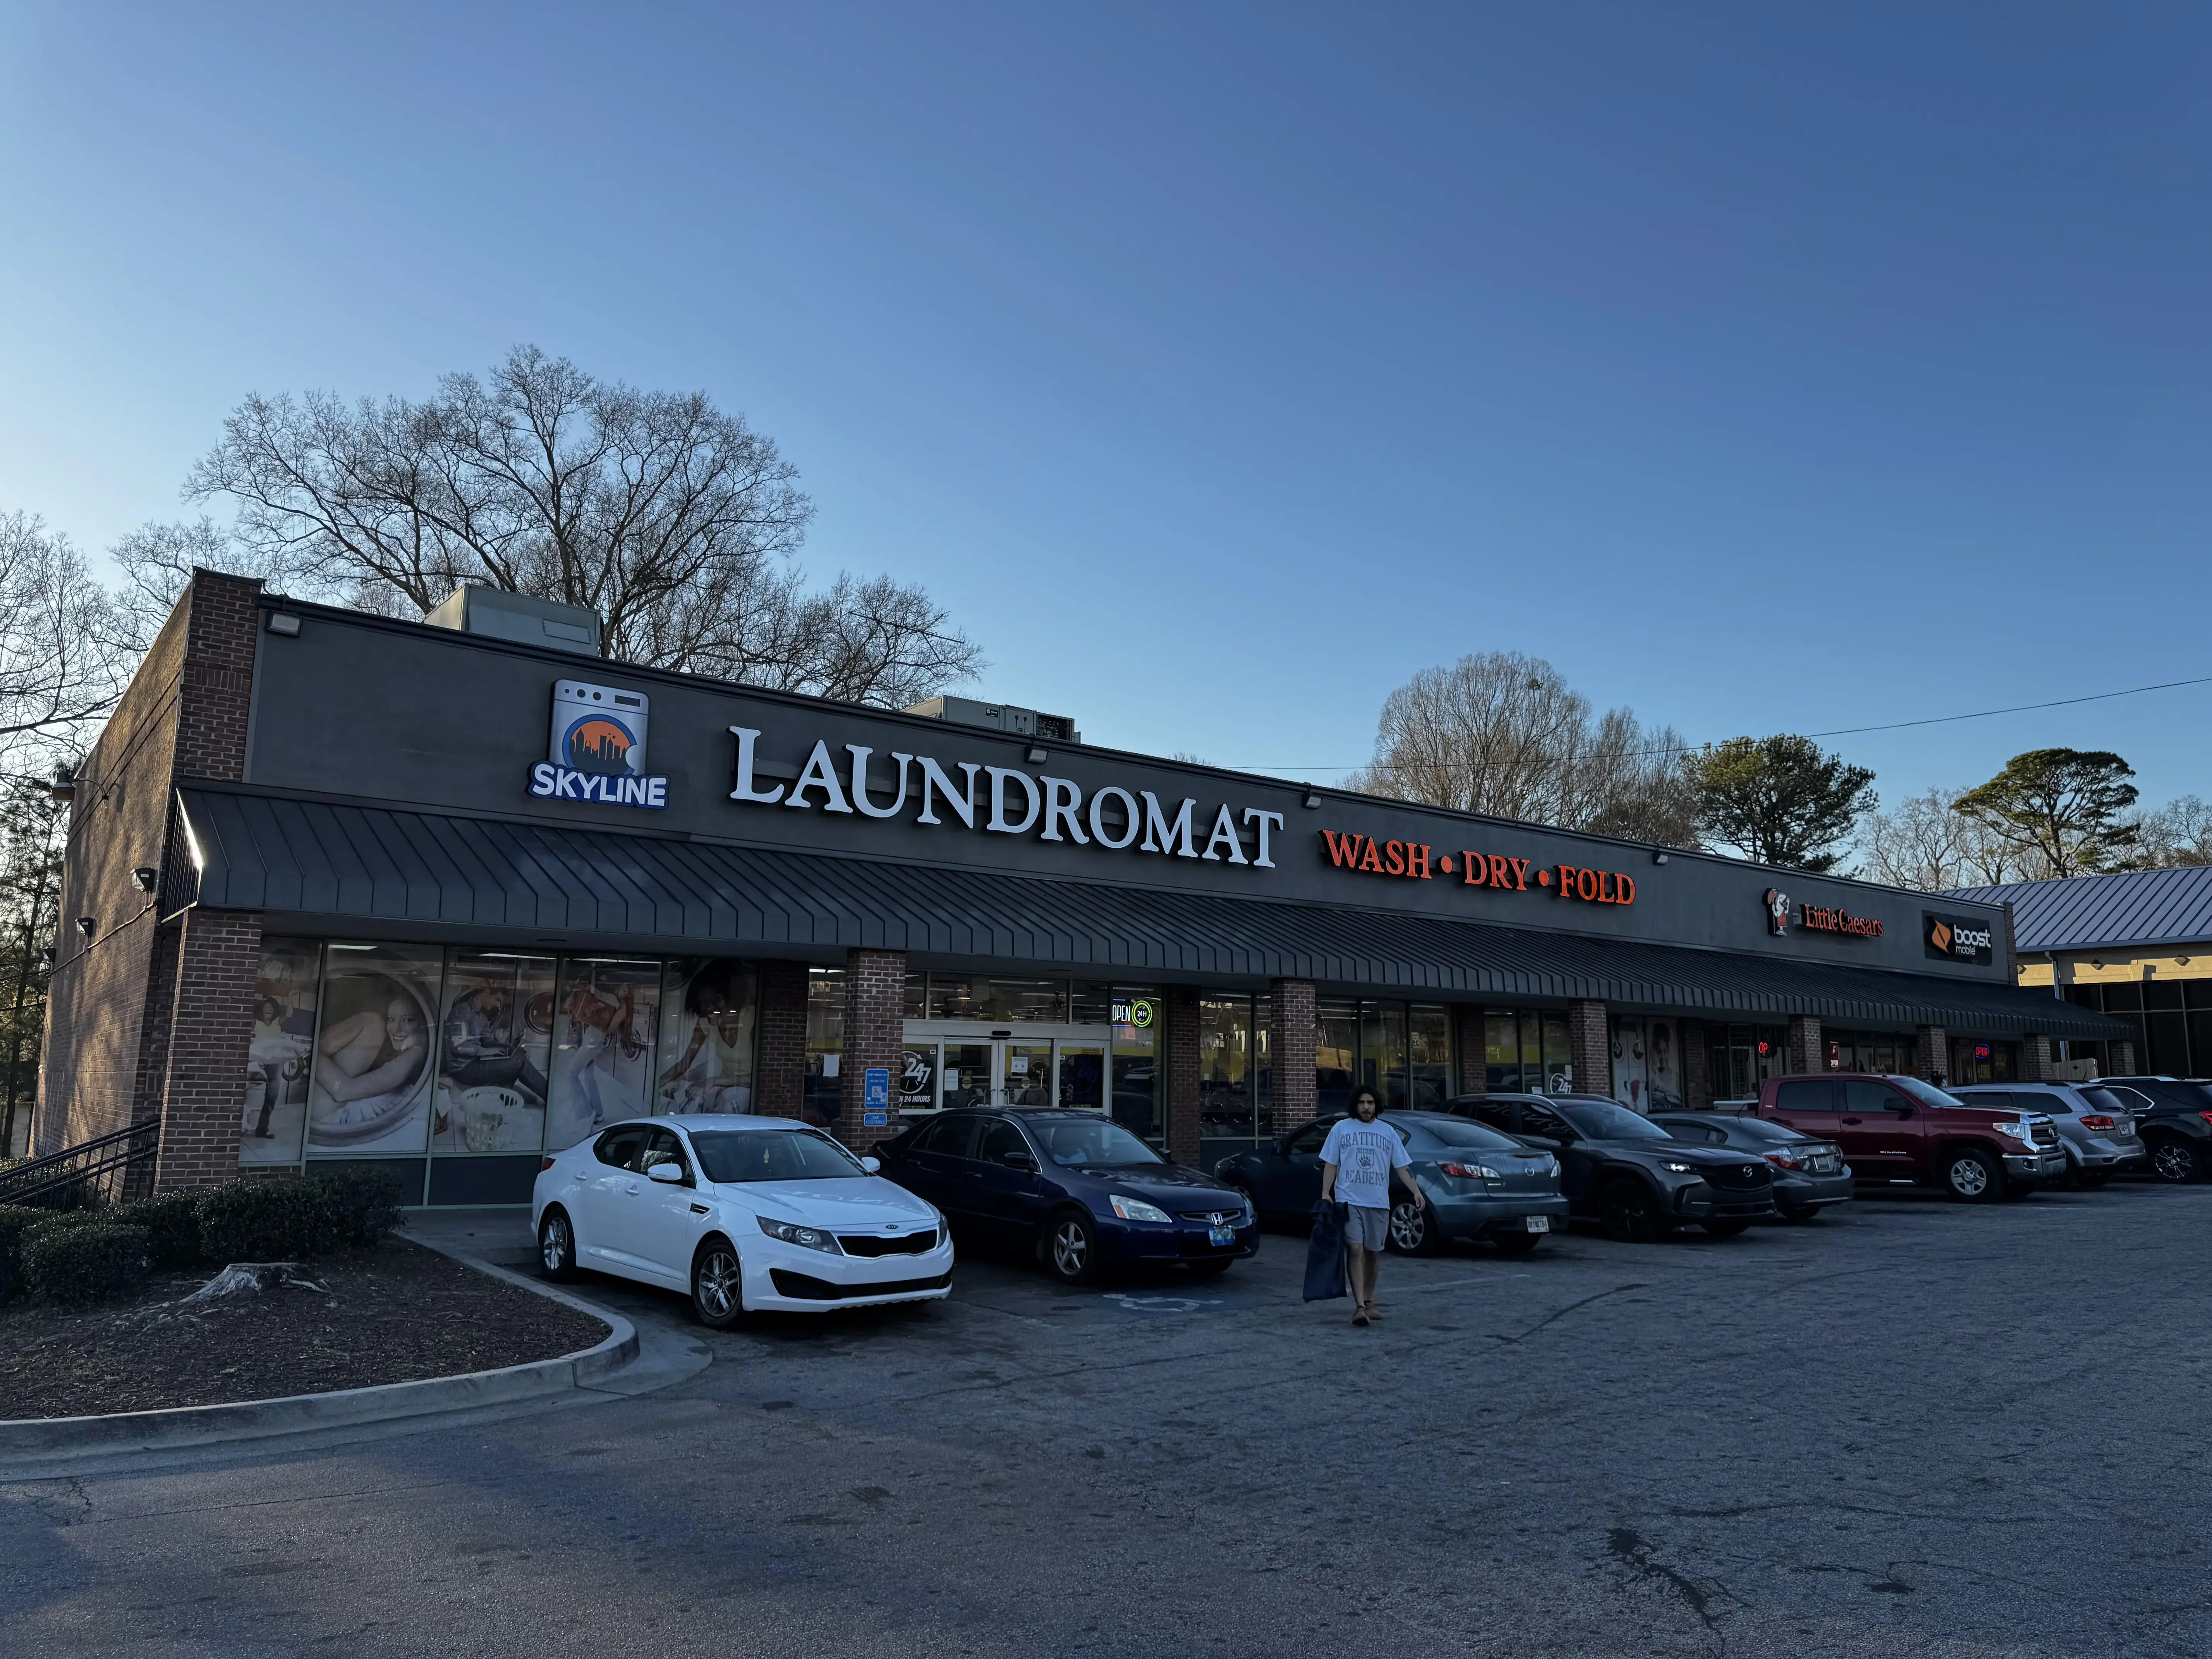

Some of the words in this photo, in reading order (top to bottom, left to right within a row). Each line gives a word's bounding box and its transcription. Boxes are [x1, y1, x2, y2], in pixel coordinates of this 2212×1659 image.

[532, 764, 666, 806] SKYLINE
[729, 726, 1284, 868] LAUNDROMAT
[1322, 830, 1432, 879] WASH
[1463, 850, 1530, 891] DRY
[1559, 865, 1636, 905] FOLD
[1804, 904, 1838, 931] Little
[1839, 908, 1884, 937] Caesars
[1954, 924, 1991, 948] boost
[1956, 945, 1976, 955] mobile
[1112, 1005, 1131, 1021] OPEN
[1340, 1132, 1391, 1154] GRATITUDE
[1345, 1169, 1386, 1186] ACADEMY
